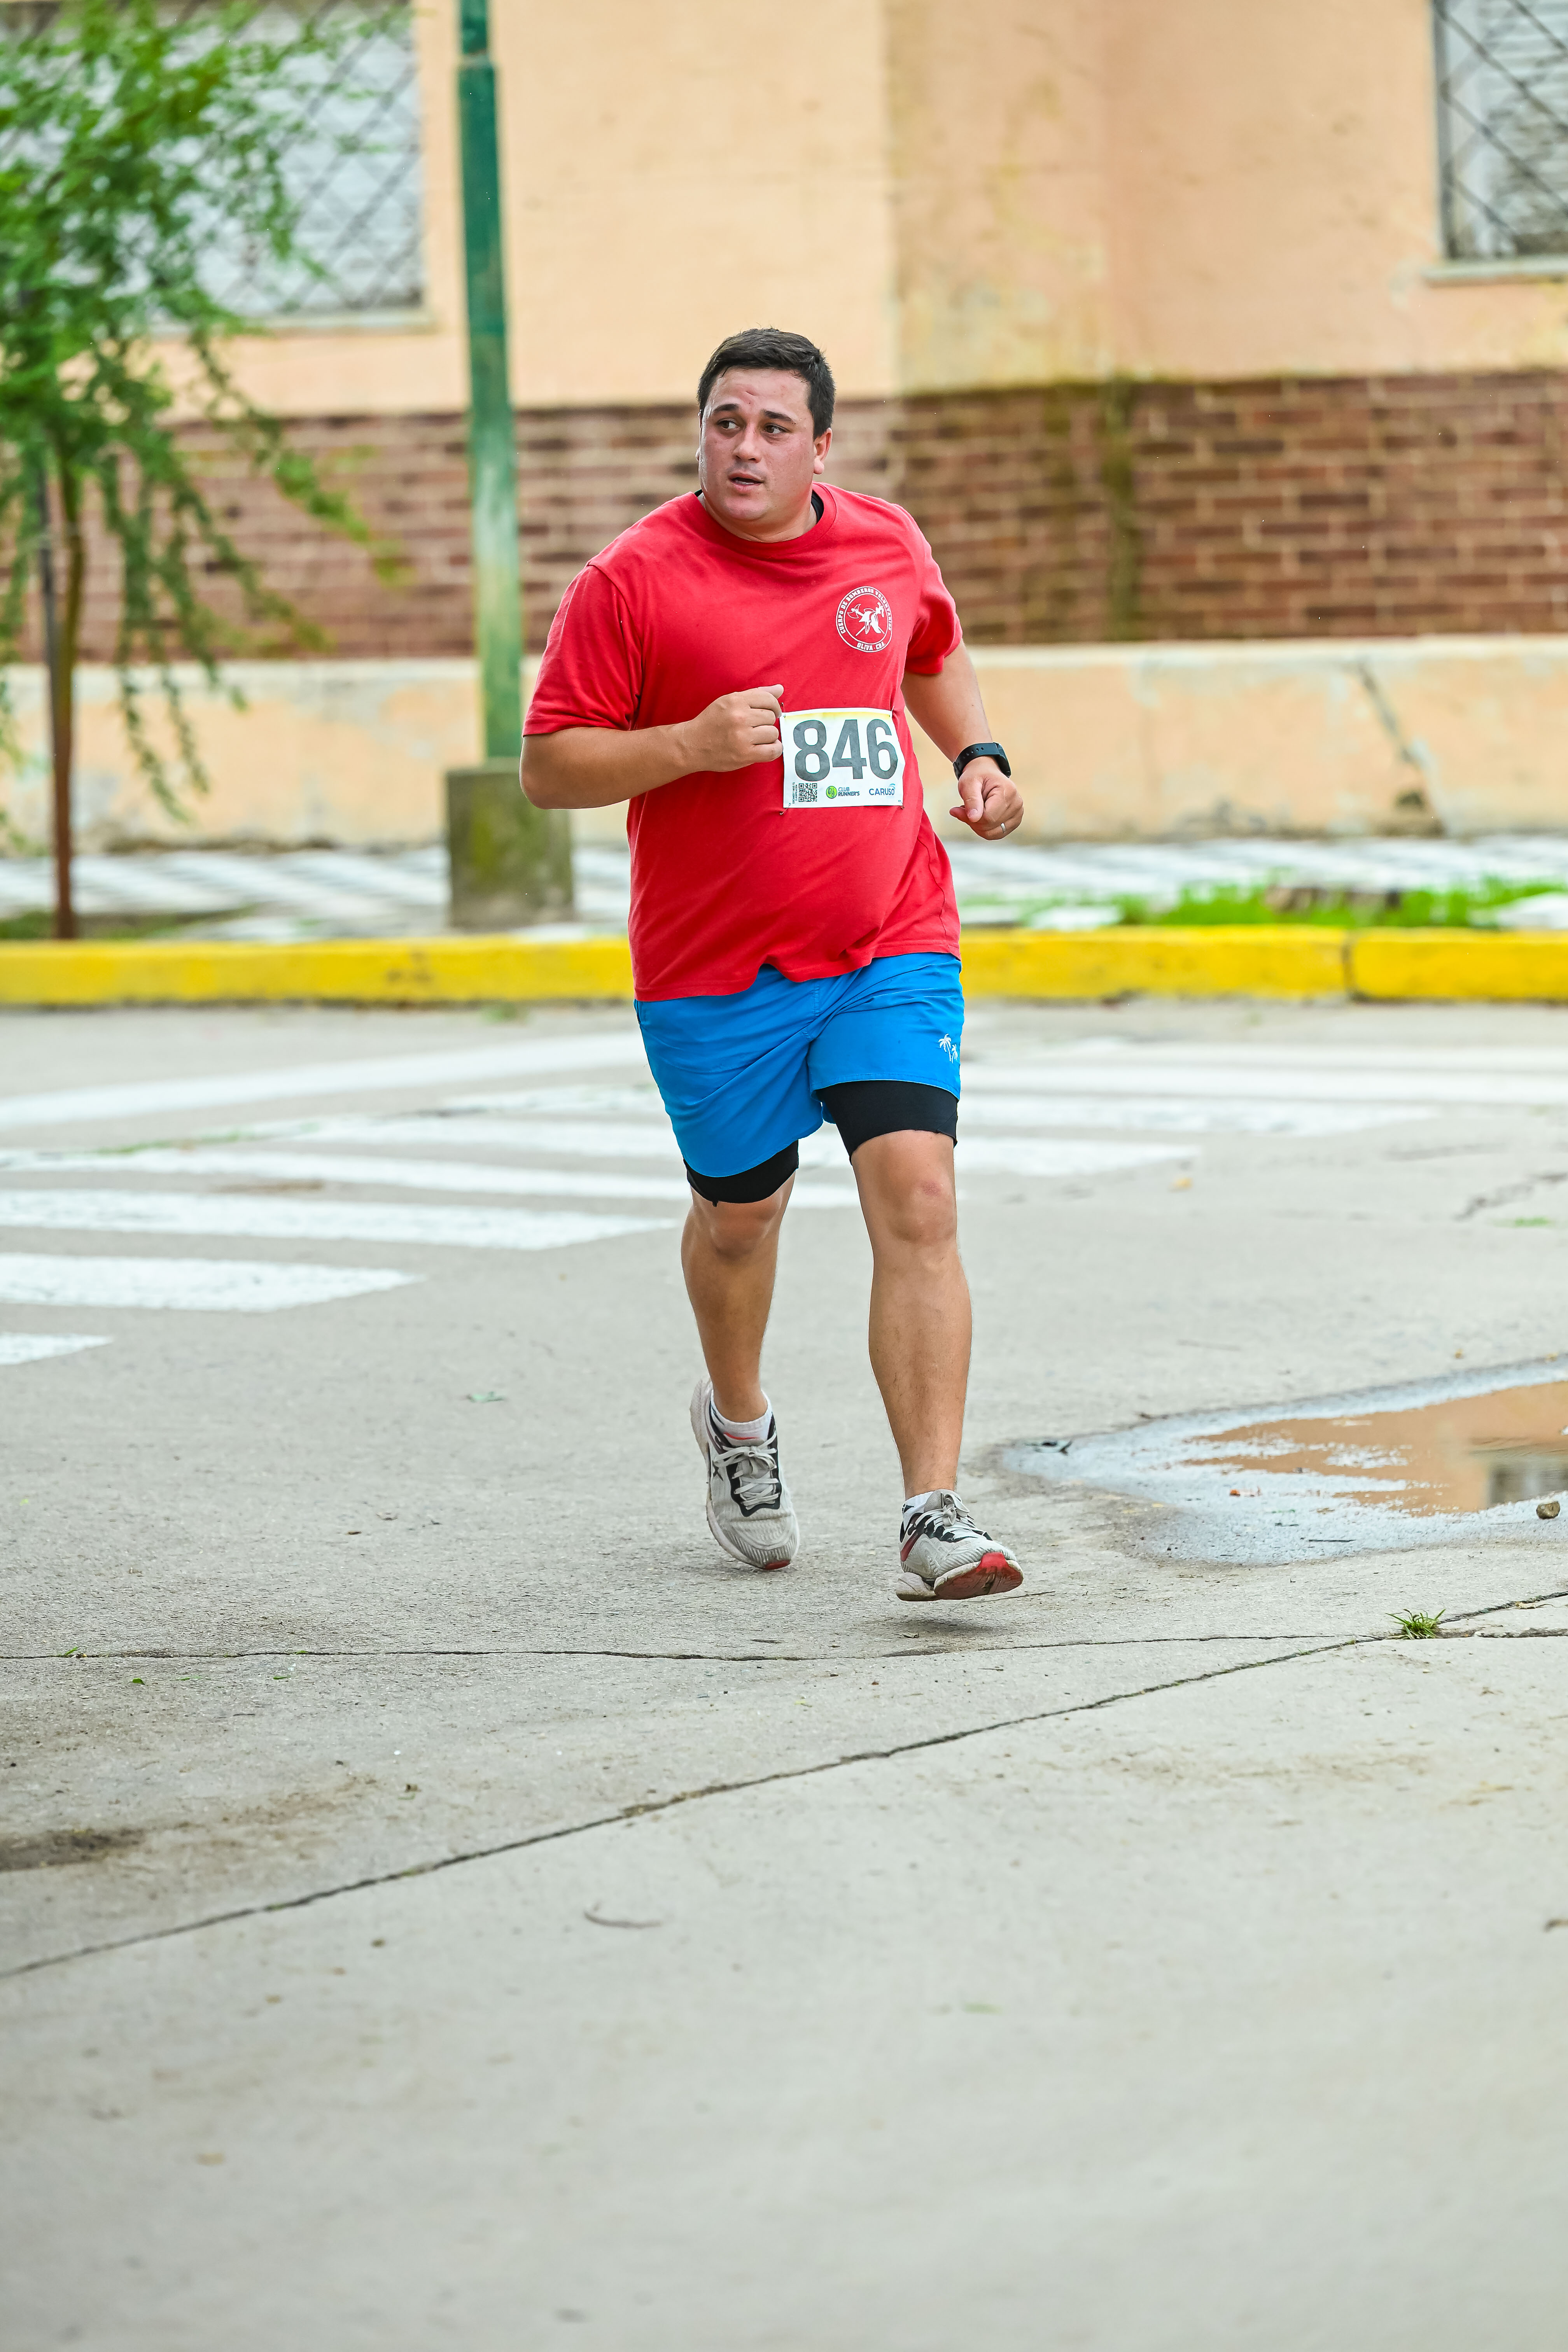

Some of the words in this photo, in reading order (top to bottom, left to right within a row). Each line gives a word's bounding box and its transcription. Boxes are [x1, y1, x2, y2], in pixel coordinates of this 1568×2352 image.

[845, 588, 874, 602] BOMBEROS
[841, 601, 848, 609] DE
[875, 591, 891, 631] VOLUNTARIOS
[837, 610, 846, 634] CUERPO
[857, 642, 873, 651] OLIVA
[793, 719, 898, 781] 846
